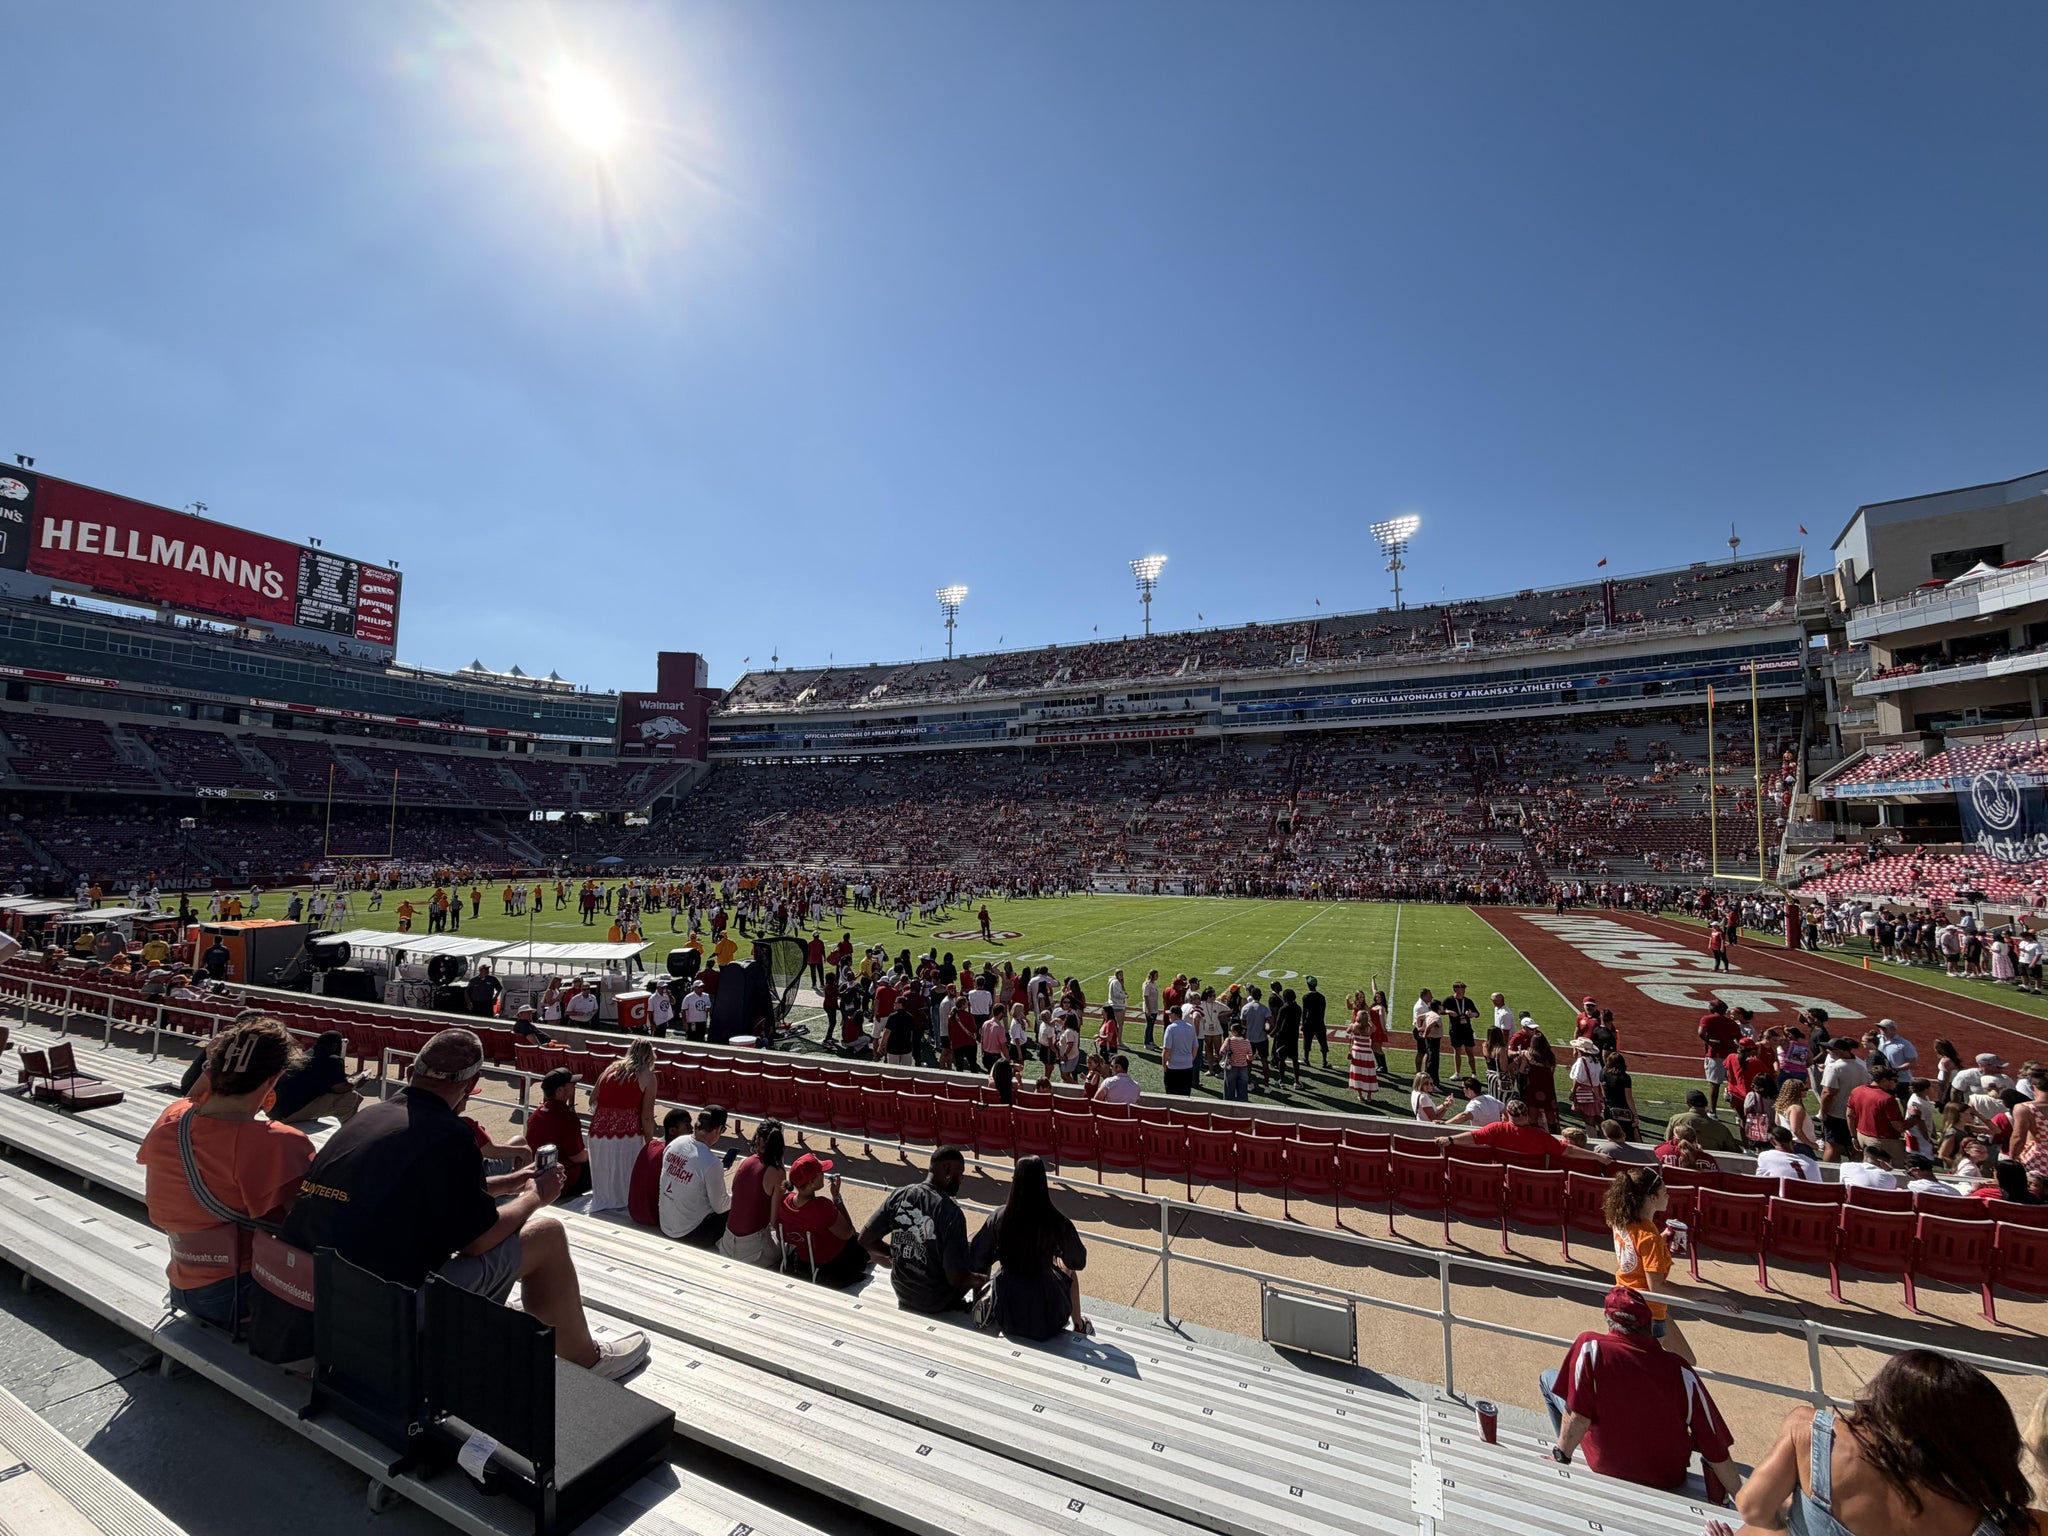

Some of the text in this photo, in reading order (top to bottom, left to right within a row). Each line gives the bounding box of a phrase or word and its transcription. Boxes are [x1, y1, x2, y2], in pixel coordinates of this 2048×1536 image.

[40, 517, 284, 599] HELLMANN'S
[362, 584, 394, 595] OREO
[360, 597, 393, 614] MAVERIK
[358, 614, 392, 627] PHILIPS
[1740, 660, 1798, 671] RAORBACKS
[65, 675, 105, 685] ARKANSAS
[1350, 696, 1389, 705] OFFICIAL
[1390, 691, 1448, 702] MAYONNAISE
[1450, 690, 1463, 699] OF
[1520, 681, 1573, 693] ATHLETICS
[639, 700, 685, 711] Walmart
[901, 727, 927, 735] ATHLETICS
[1035, 727, 1195, 743] HOME OF THE RAZORBACKS
[111, 878, 212, 891] ARKANSAS
[630, 1003, 645, 1019] G
[667, 1164, 694, 1182] ROACH
